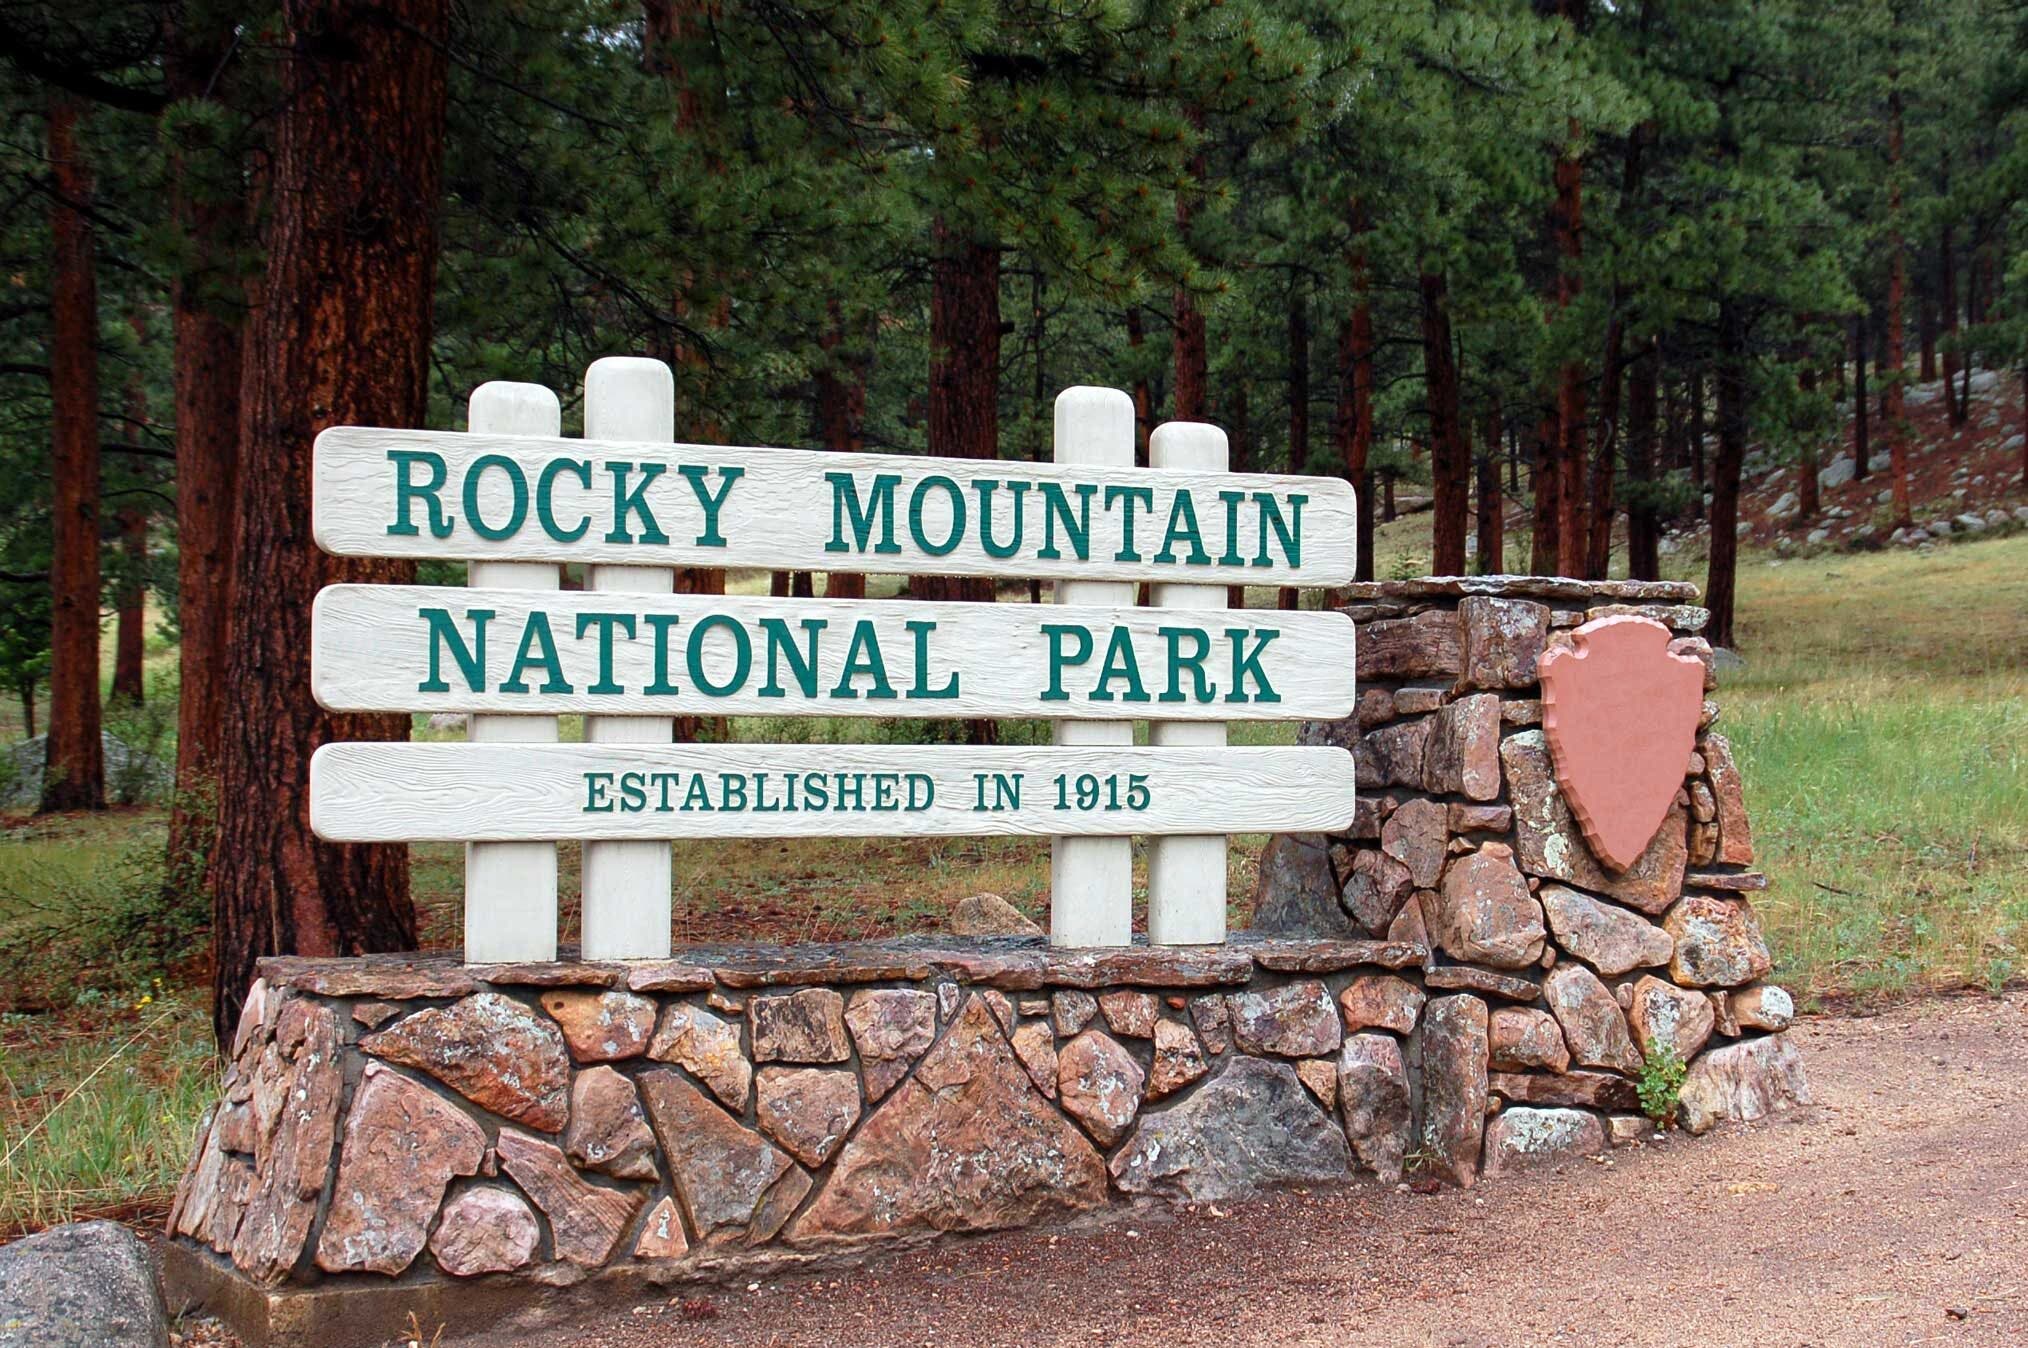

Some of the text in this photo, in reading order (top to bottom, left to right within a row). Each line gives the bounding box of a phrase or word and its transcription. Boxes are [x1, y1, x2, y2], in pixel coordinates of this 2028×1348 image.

[387, 450, 1309, 569] ROCKY MOUNTAIN
[419, 608, 1282, 704] NATIONAL PARK
[583, 770, 1151, 814] ESTABLISHED IN 1915
